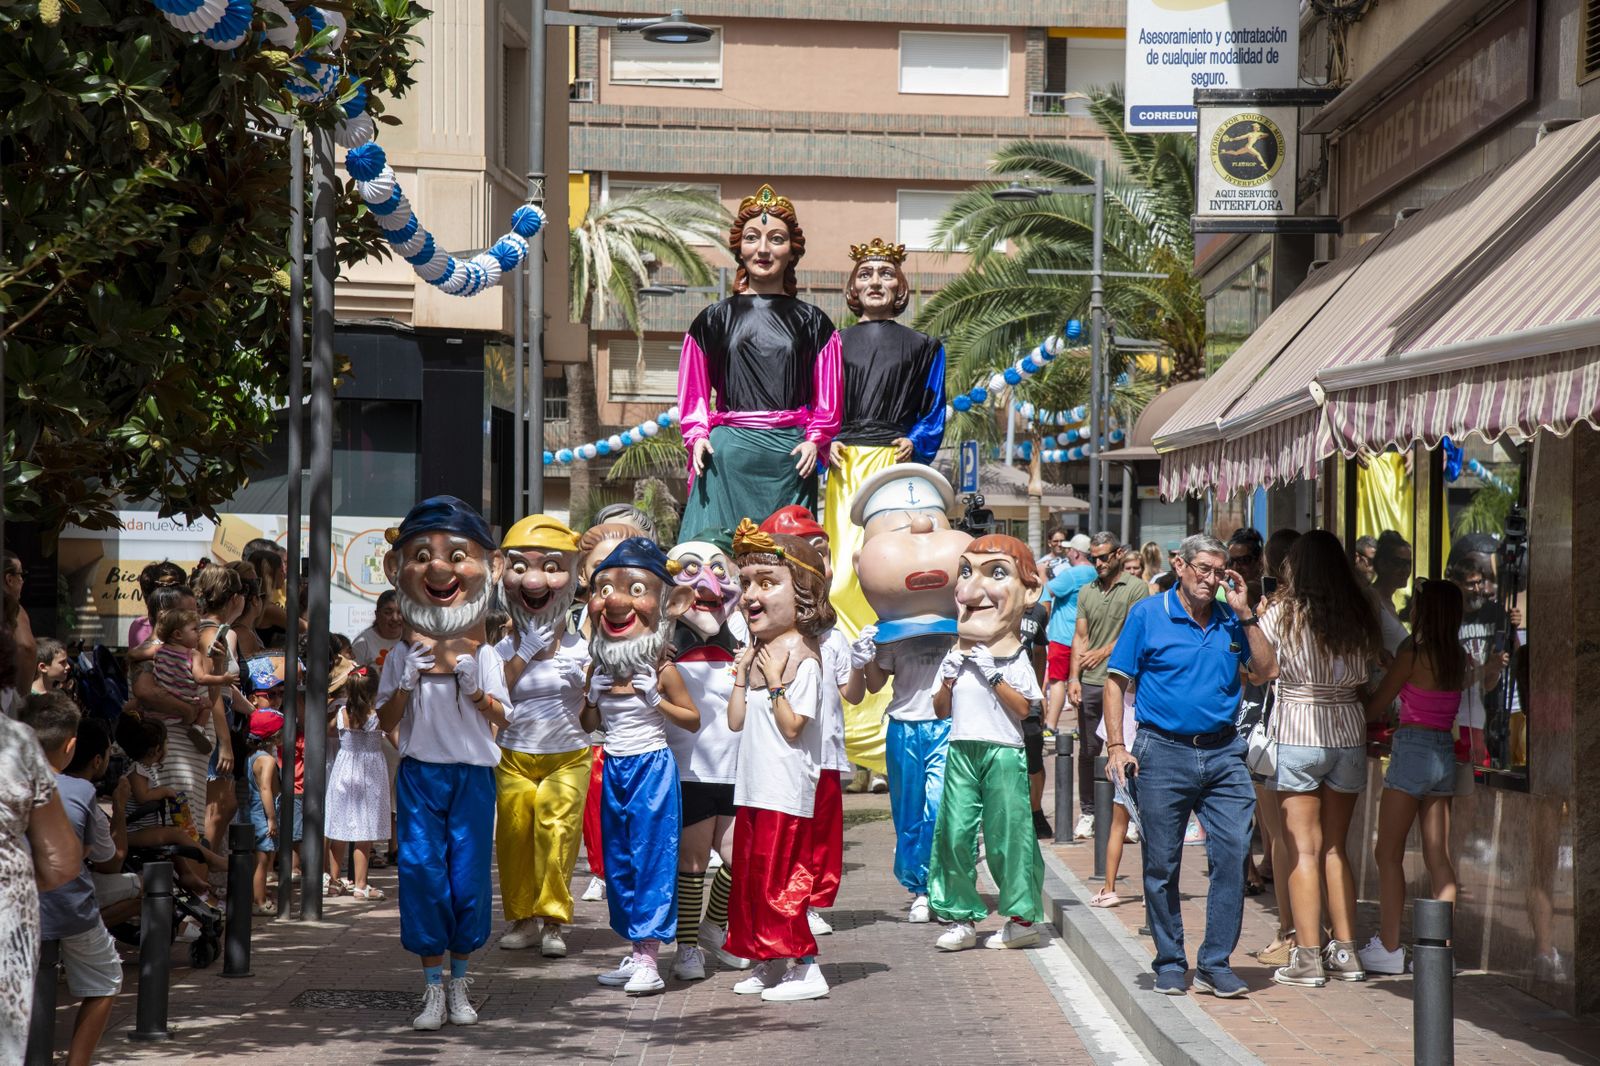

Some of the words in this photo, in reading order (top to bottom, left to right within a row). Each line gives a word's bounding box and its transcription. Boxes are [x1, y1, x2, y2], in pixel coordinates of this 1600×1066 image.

[1138, 28, 1213, 45] Asesoramiento
[1215, 30, 1223, 47] y
[1224, 26, 1288, 44] contratación
[1146, 48, 1159, 65] de
[1162, 48, 1207, 68] cualquier
[1210, 47, 1263, 65] modalidad
[1266, 46, 1279, 64] de
[1191, 71, 1229, 88] seguro.
[1211, 127, 1225, 156] FLORES
[1224, 116, 1240, 128] POR
[1264, 119, 1273, 128] EL
[1274, 128, 1284, 157] MUNDO
[1352, 99, 1416, 193] FLORES
[1224, 173, 1272, 187] INTERFLORA
[215, 190, 236, 199] AQUI
[1238, 189, 1279, 198] SERVICIO
[1209, 200, 1283, 211] INTERFLORA
[1020, 617, 1039, 635] NES
